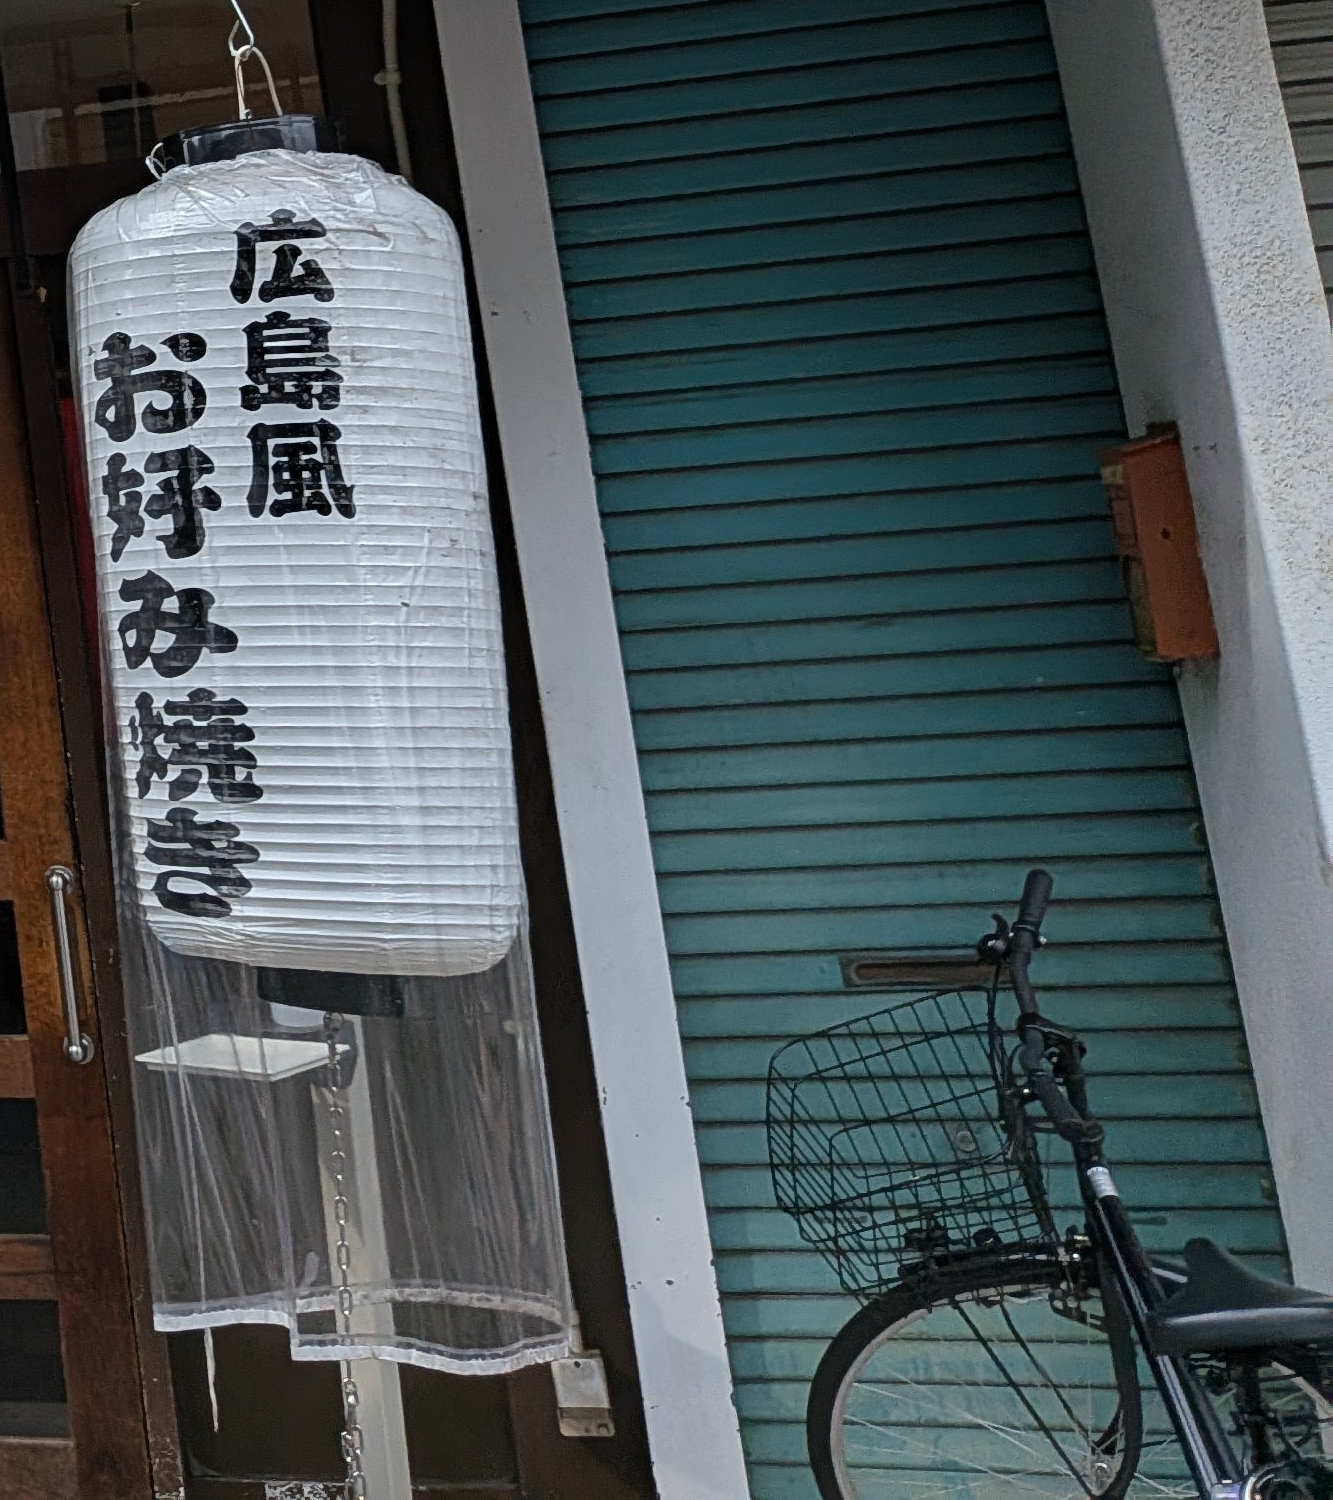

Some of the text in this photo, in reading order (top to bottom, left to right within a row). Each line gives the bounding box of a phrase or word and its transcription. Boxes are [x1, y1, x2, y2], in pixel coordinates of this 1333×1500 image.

[229, 209, 356, 520] 広島風
[92, 331, 264, 919] お好み焼き
